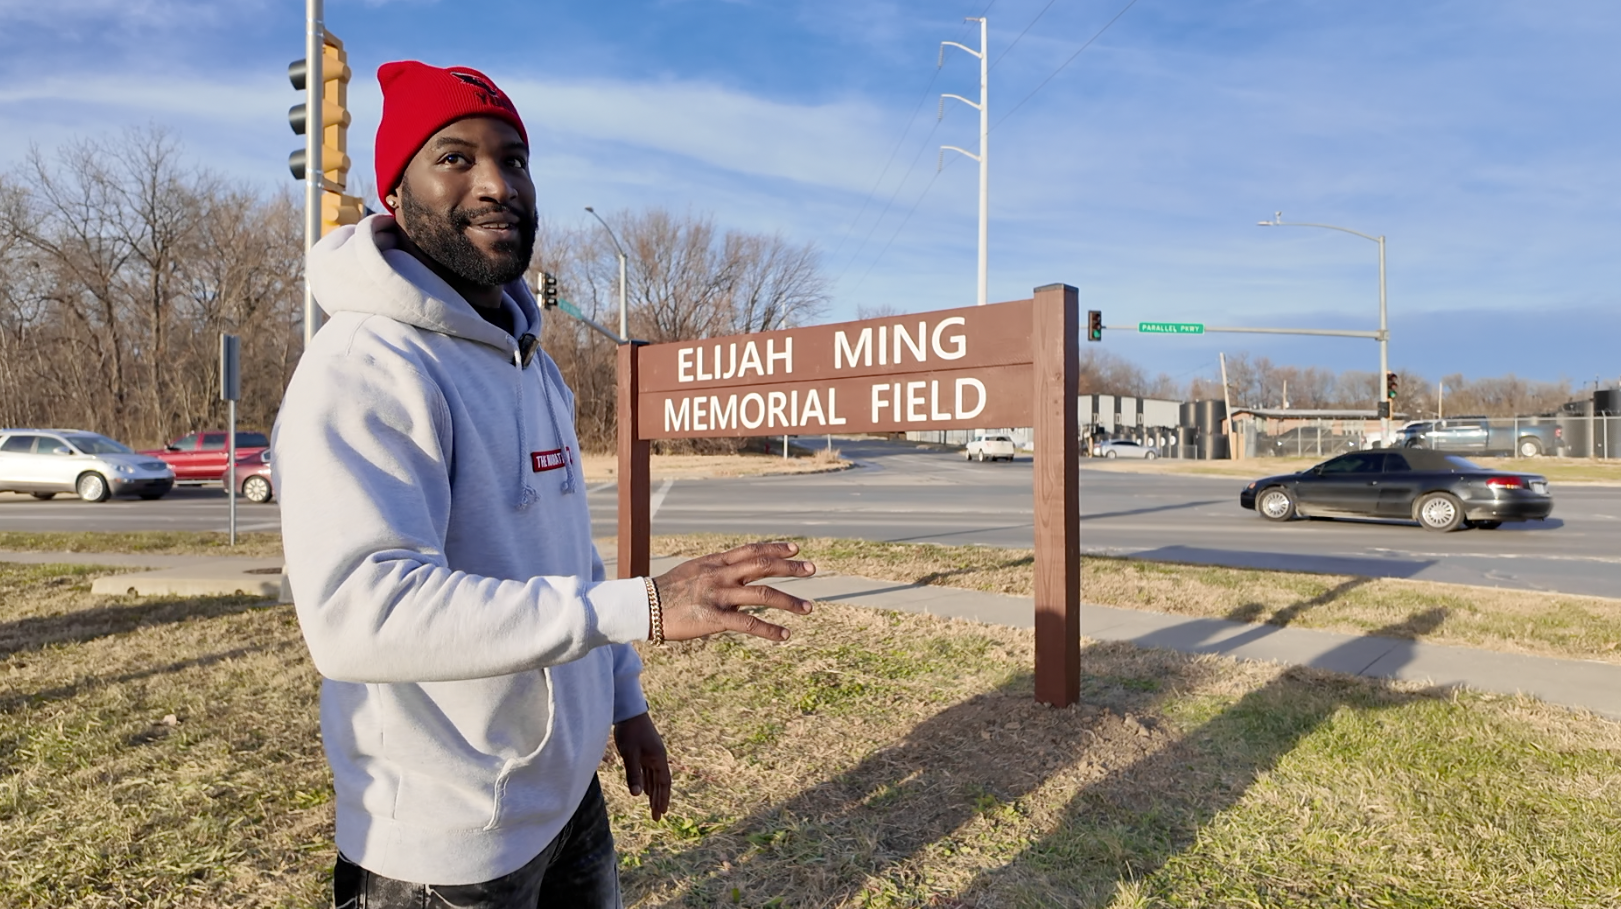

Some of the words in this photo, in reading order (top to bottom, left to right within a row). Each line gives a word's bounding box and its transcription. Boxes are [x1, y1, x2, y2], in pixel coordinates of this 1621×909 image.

[678, 337, 793, 383] ELIJAH
[834, 316, 967, 369] MING
[1142, 324, 1177, 333] PARALLEL
[664, 387, 847, 432] MEMORIAL
[871, 377, 987, 424] FIELD
